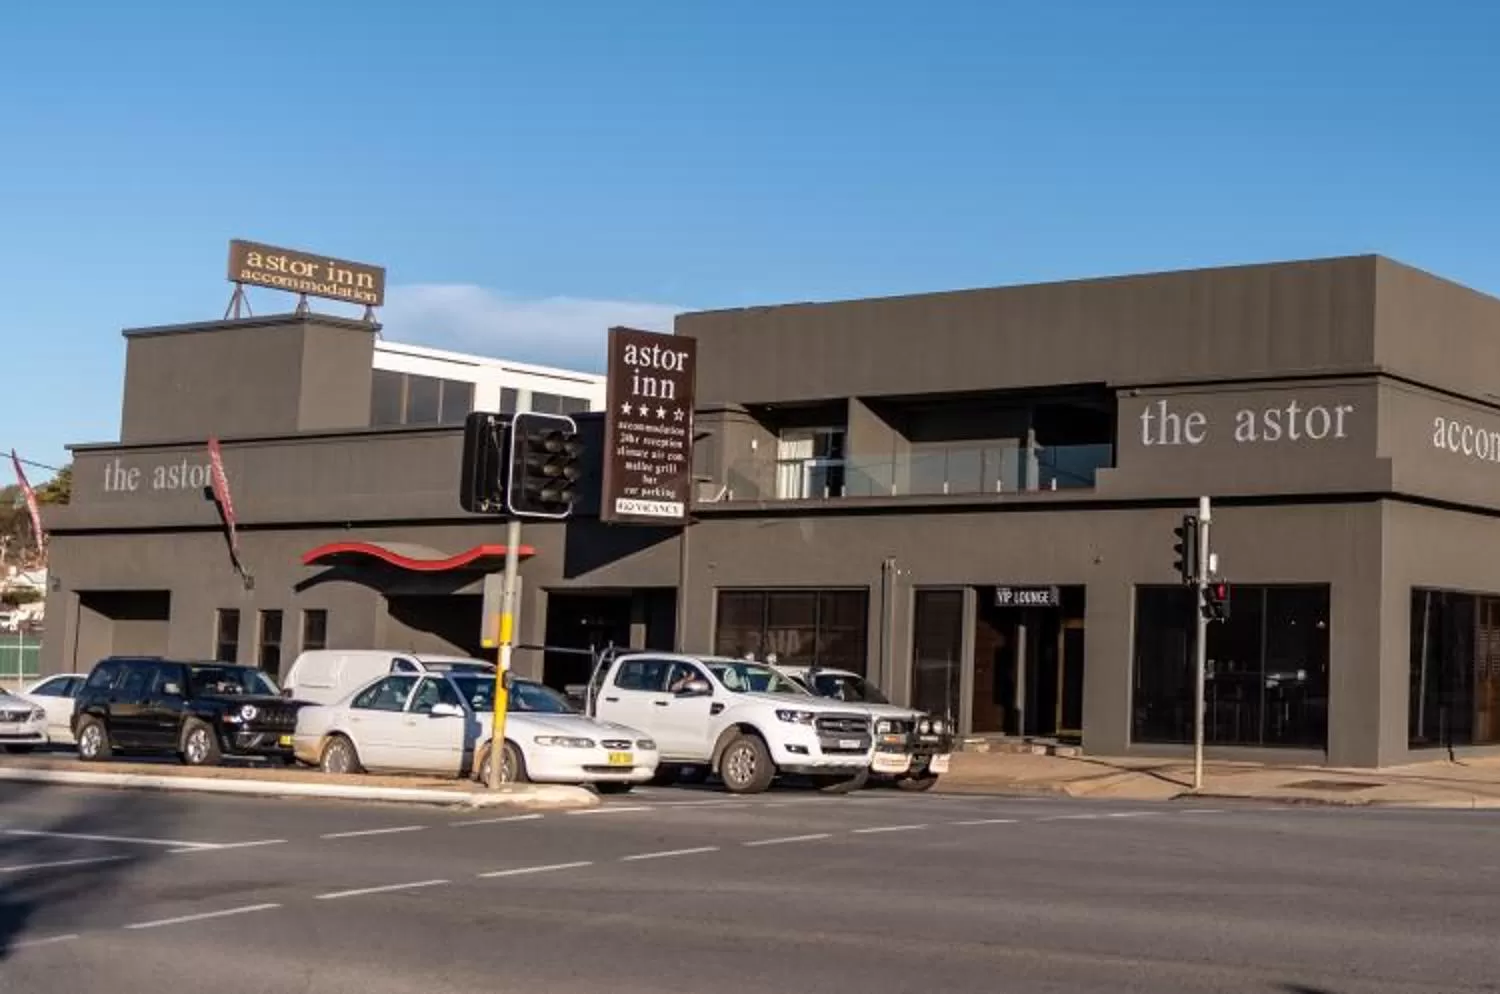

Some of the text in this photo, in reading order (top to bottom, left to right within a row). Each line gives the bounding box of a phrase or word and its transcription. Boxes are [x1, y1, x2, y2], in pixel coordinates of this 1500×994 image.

[240, 269, 377, 302] accommodation
[247, 251, 374, 289] astor inn
[623, 343, 689, 400] astor inn
[1139, 399, 1353, 446] the astor
[104, 458, 141, 491] the
[153, 458, 213, 489] astor
[1013, 591, 1049, 604] LOUNGE
